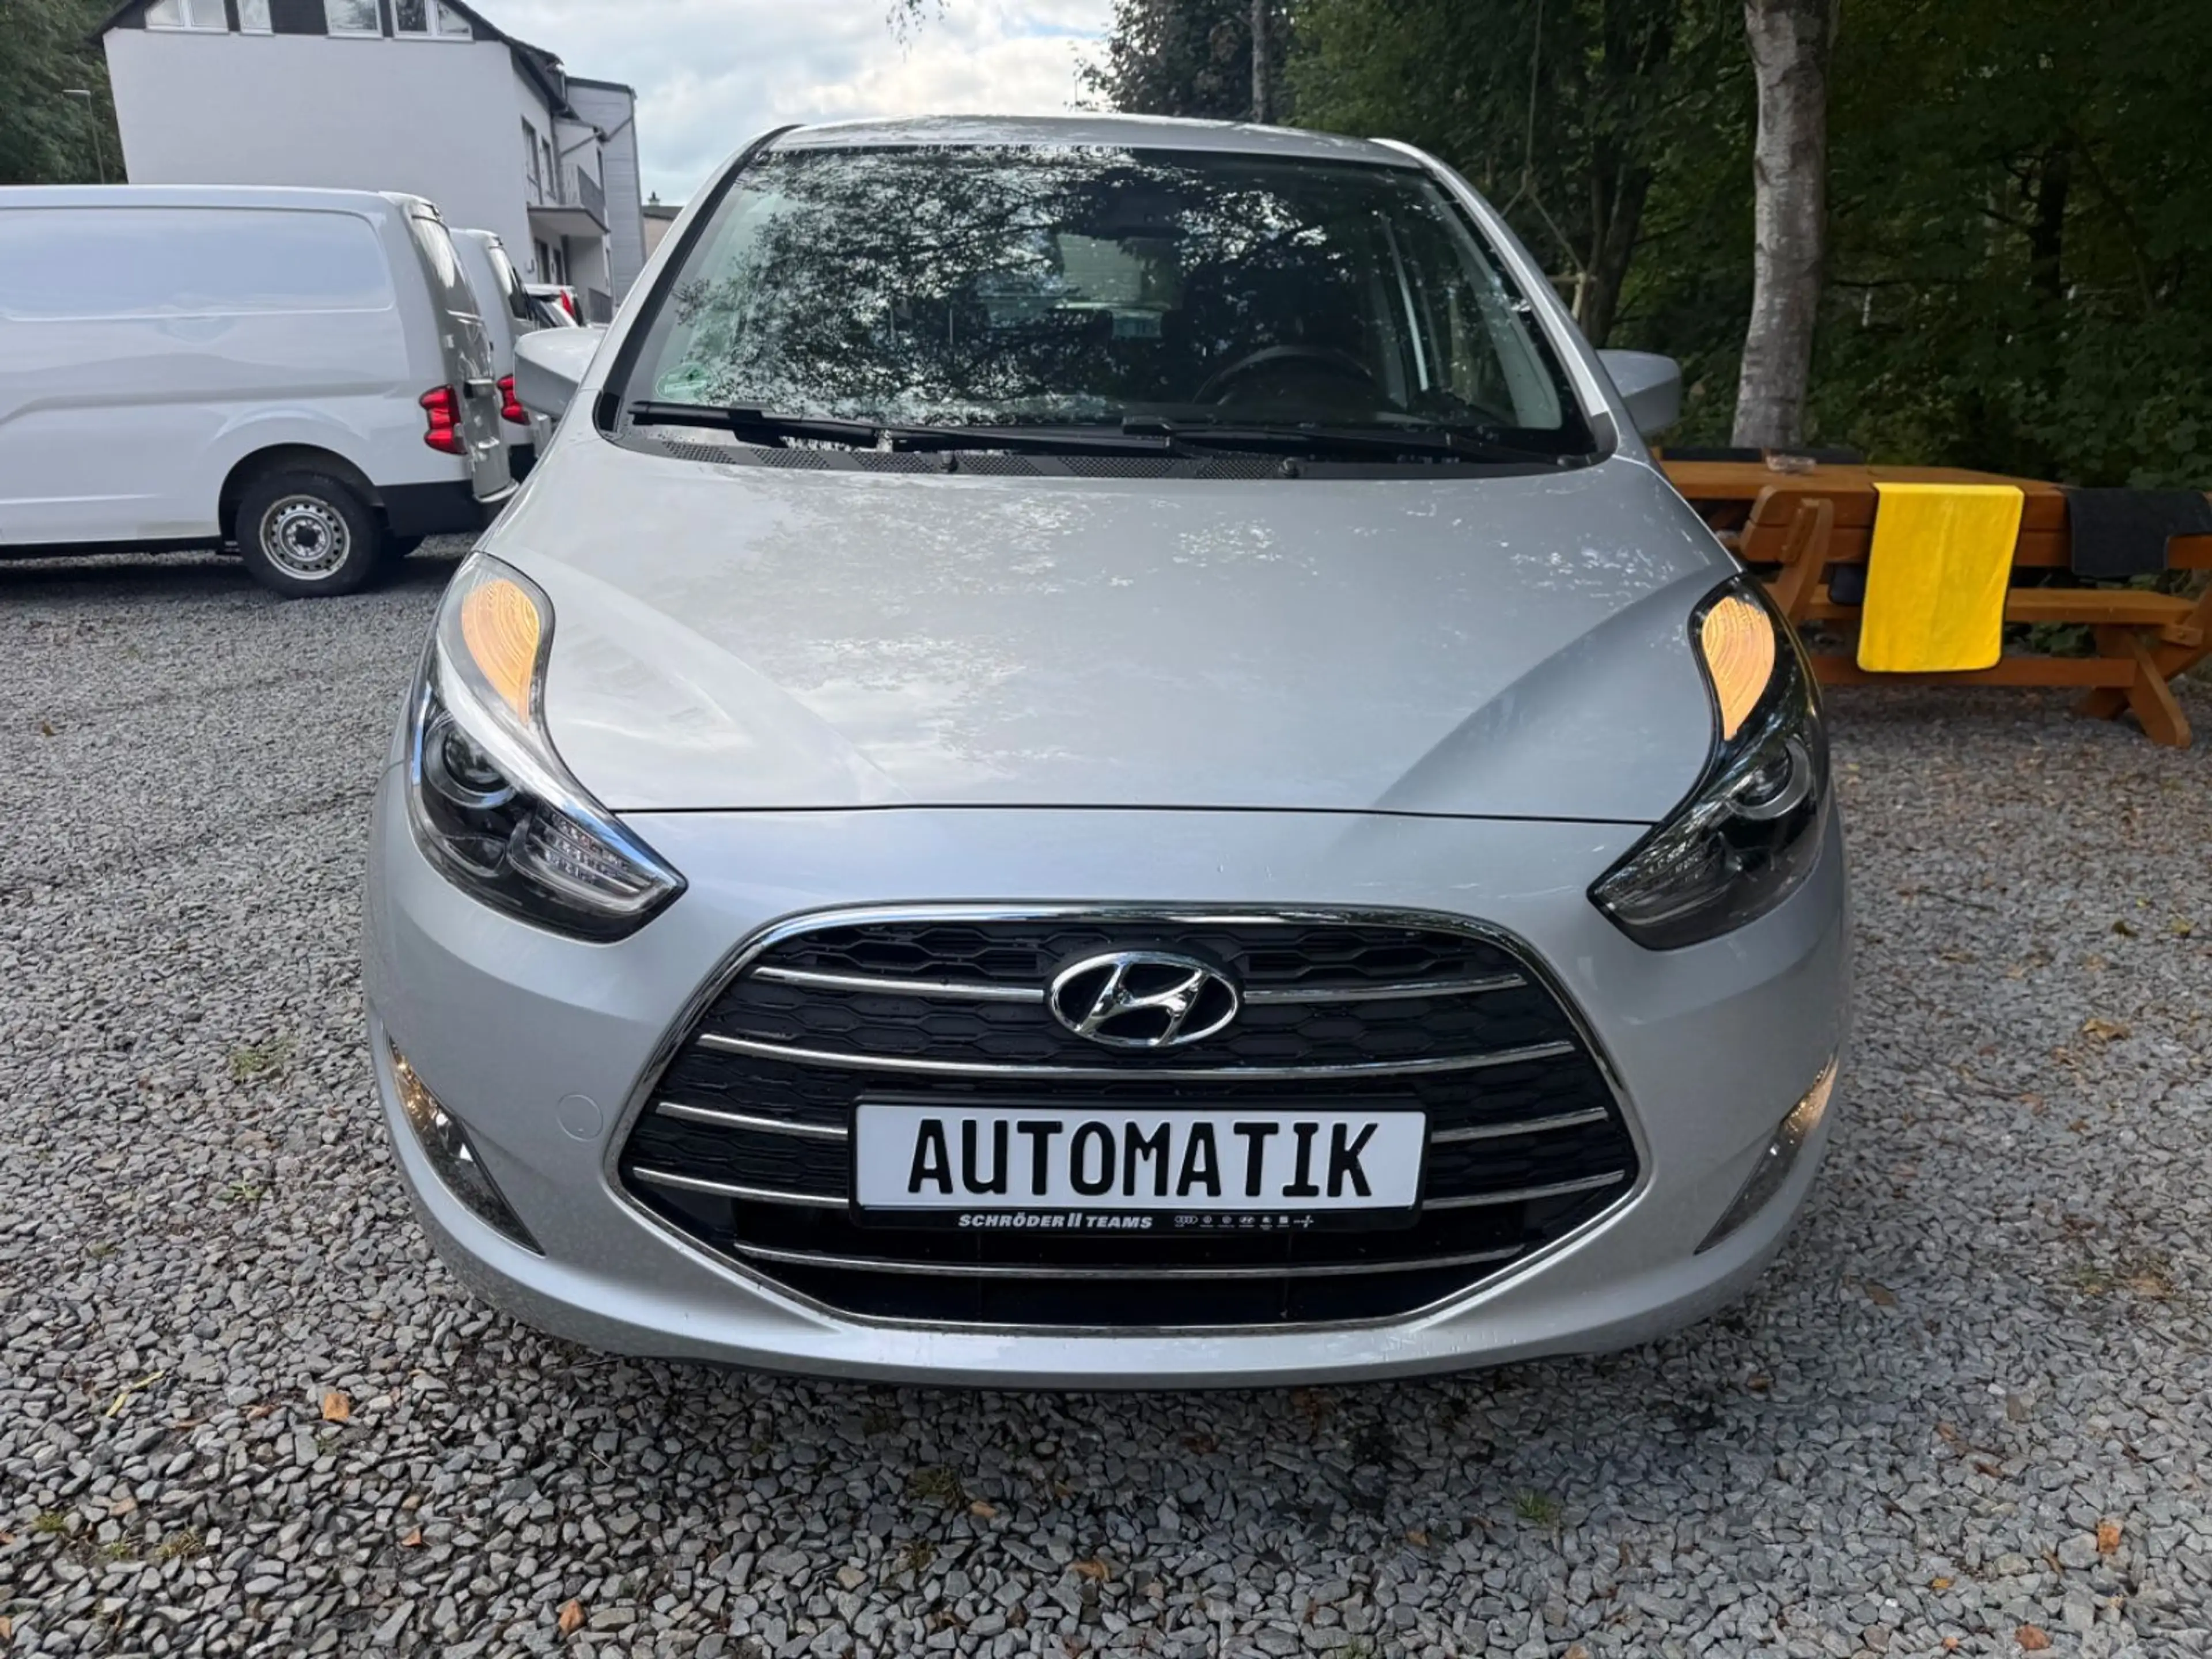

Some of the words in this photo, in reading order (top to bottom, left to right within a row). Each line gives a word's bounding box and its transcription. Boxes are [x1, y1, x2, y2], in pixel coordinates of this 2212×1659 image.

[908, 1119, 1378, 1197] AUTOMATIK
[958, 1212, 1065, 1228] SCHRÖDER
[1086, 1216, 1153, 1229] TEAMS
